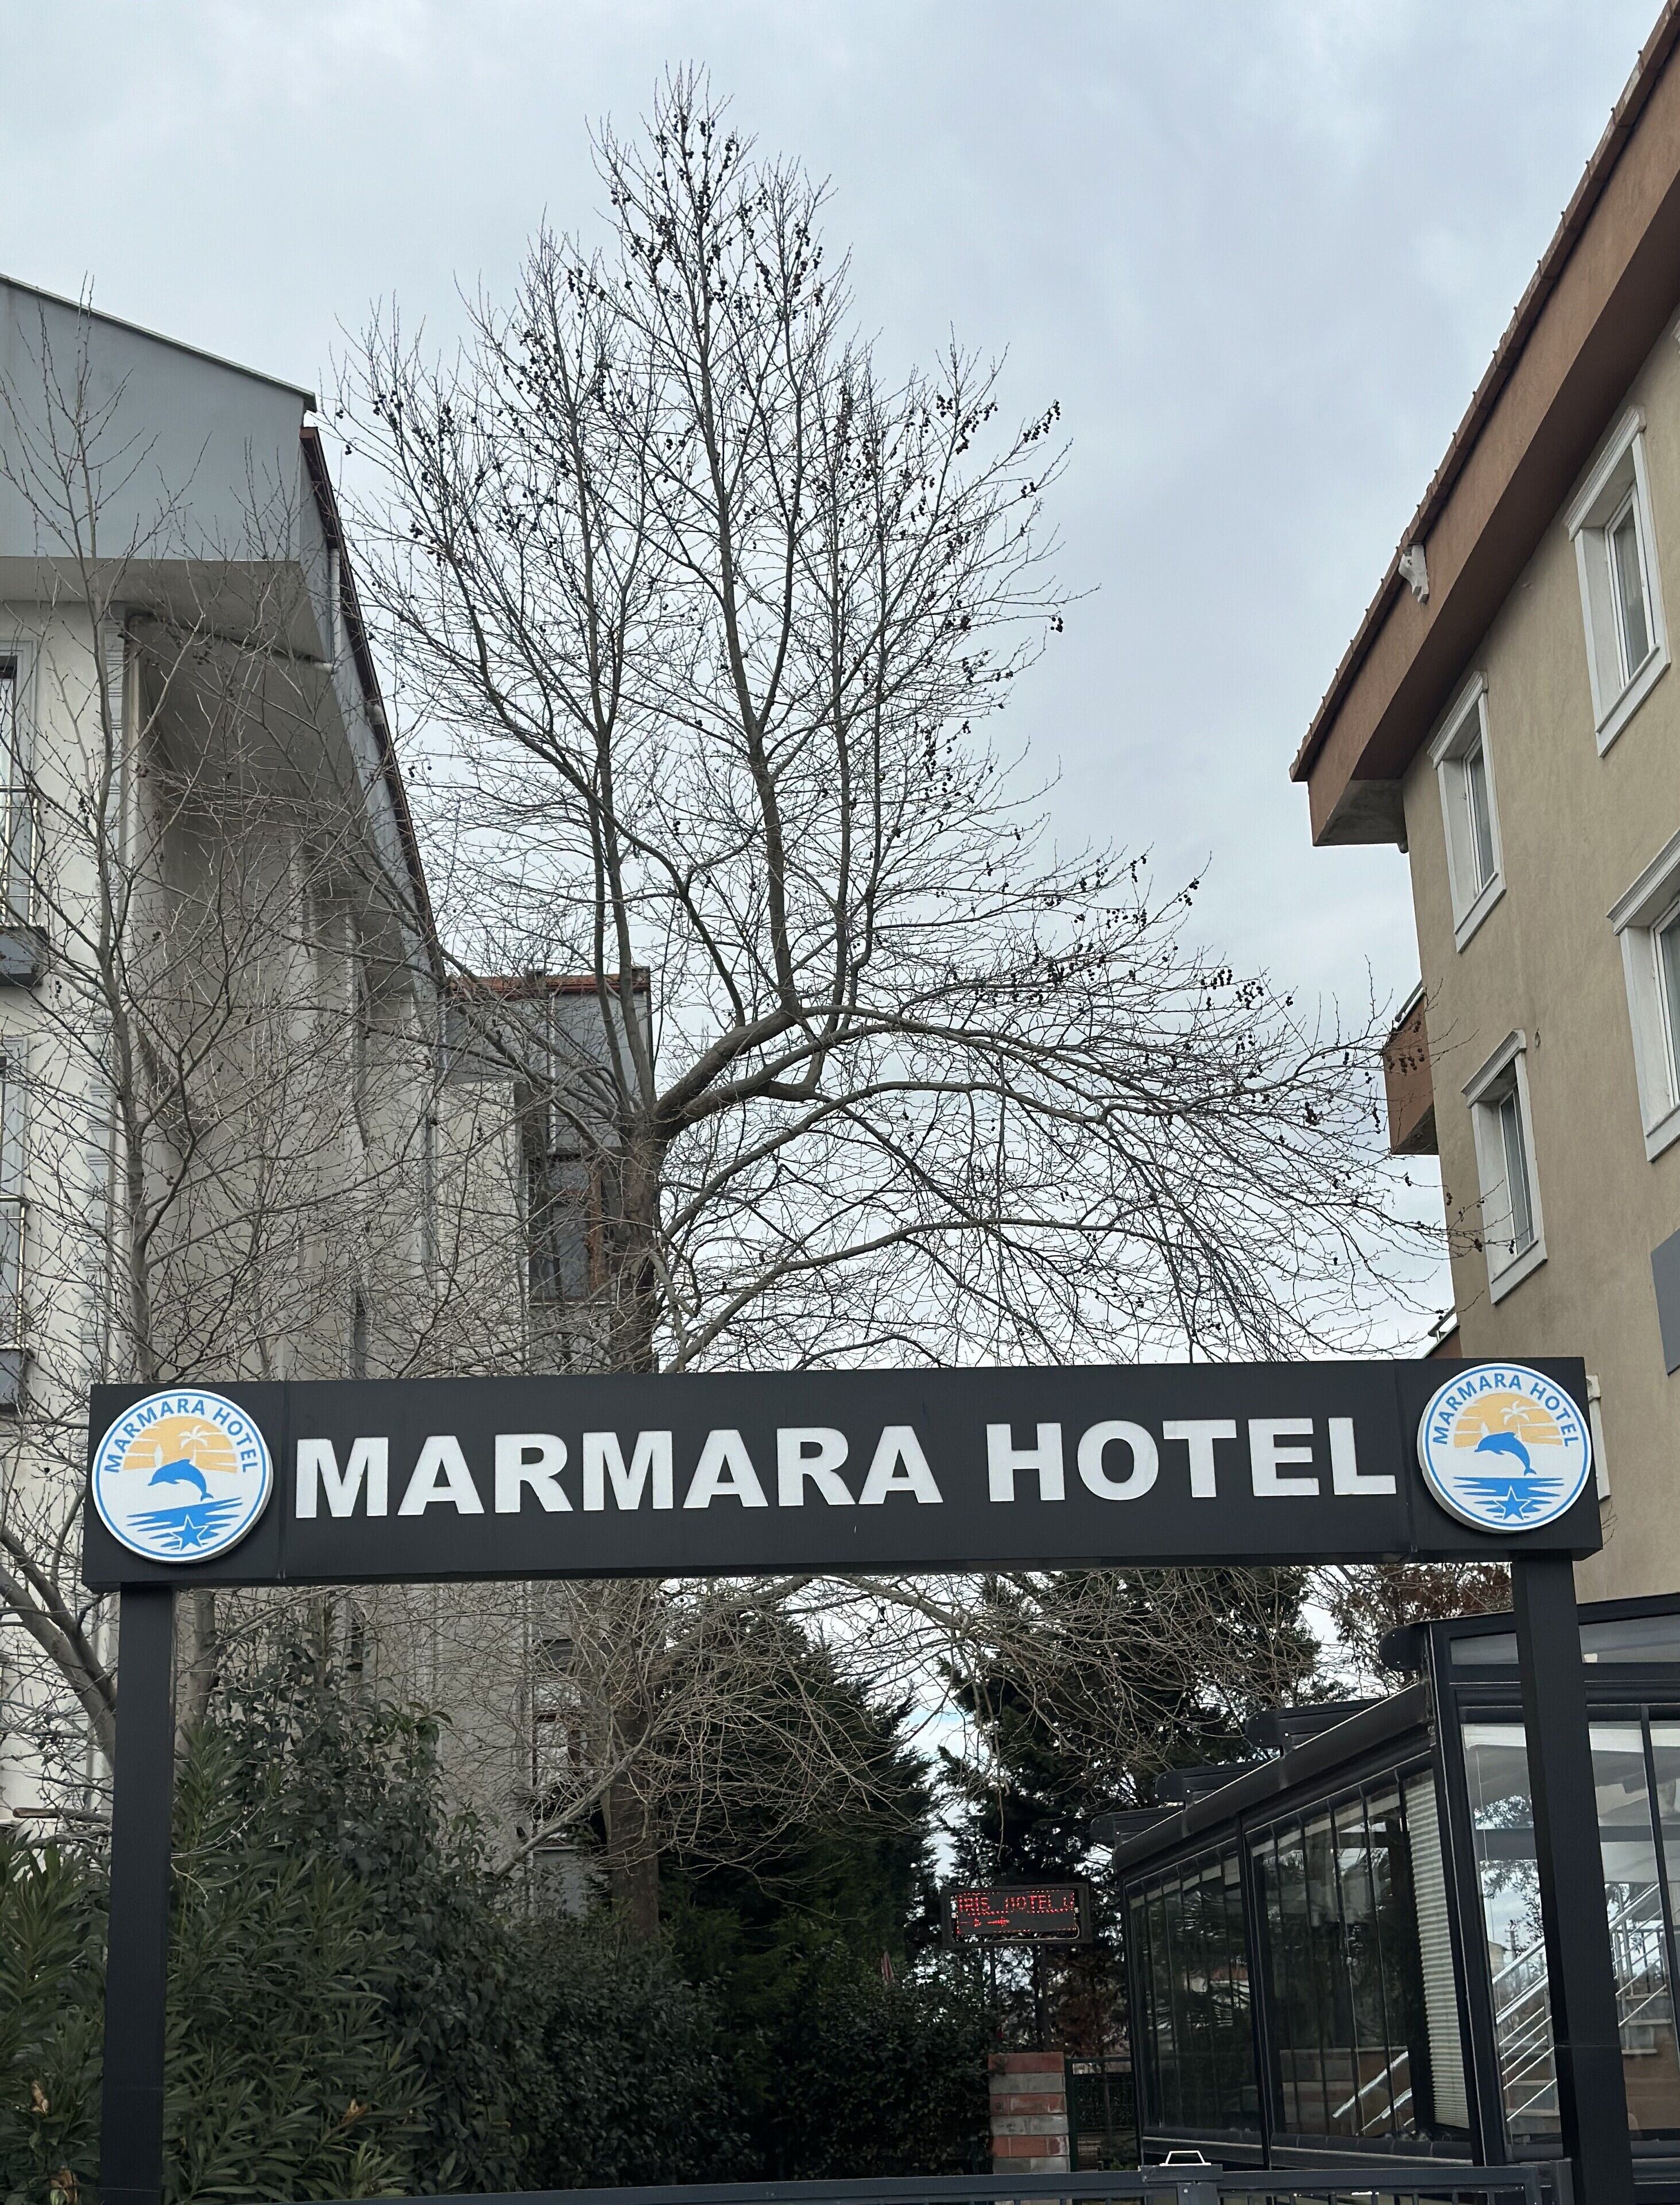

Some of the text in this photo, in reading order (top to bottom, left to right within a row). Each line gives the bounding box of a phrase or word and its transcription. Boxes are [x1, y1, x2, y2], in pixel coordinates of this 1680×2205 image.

[104, 1398, 258, 1473] MARMARA HOTEL
[1432, 1372, 1579, 1447] MARMARA HOTEL
[295, 1417, 1397, 1519] MARMARA HOTEL
